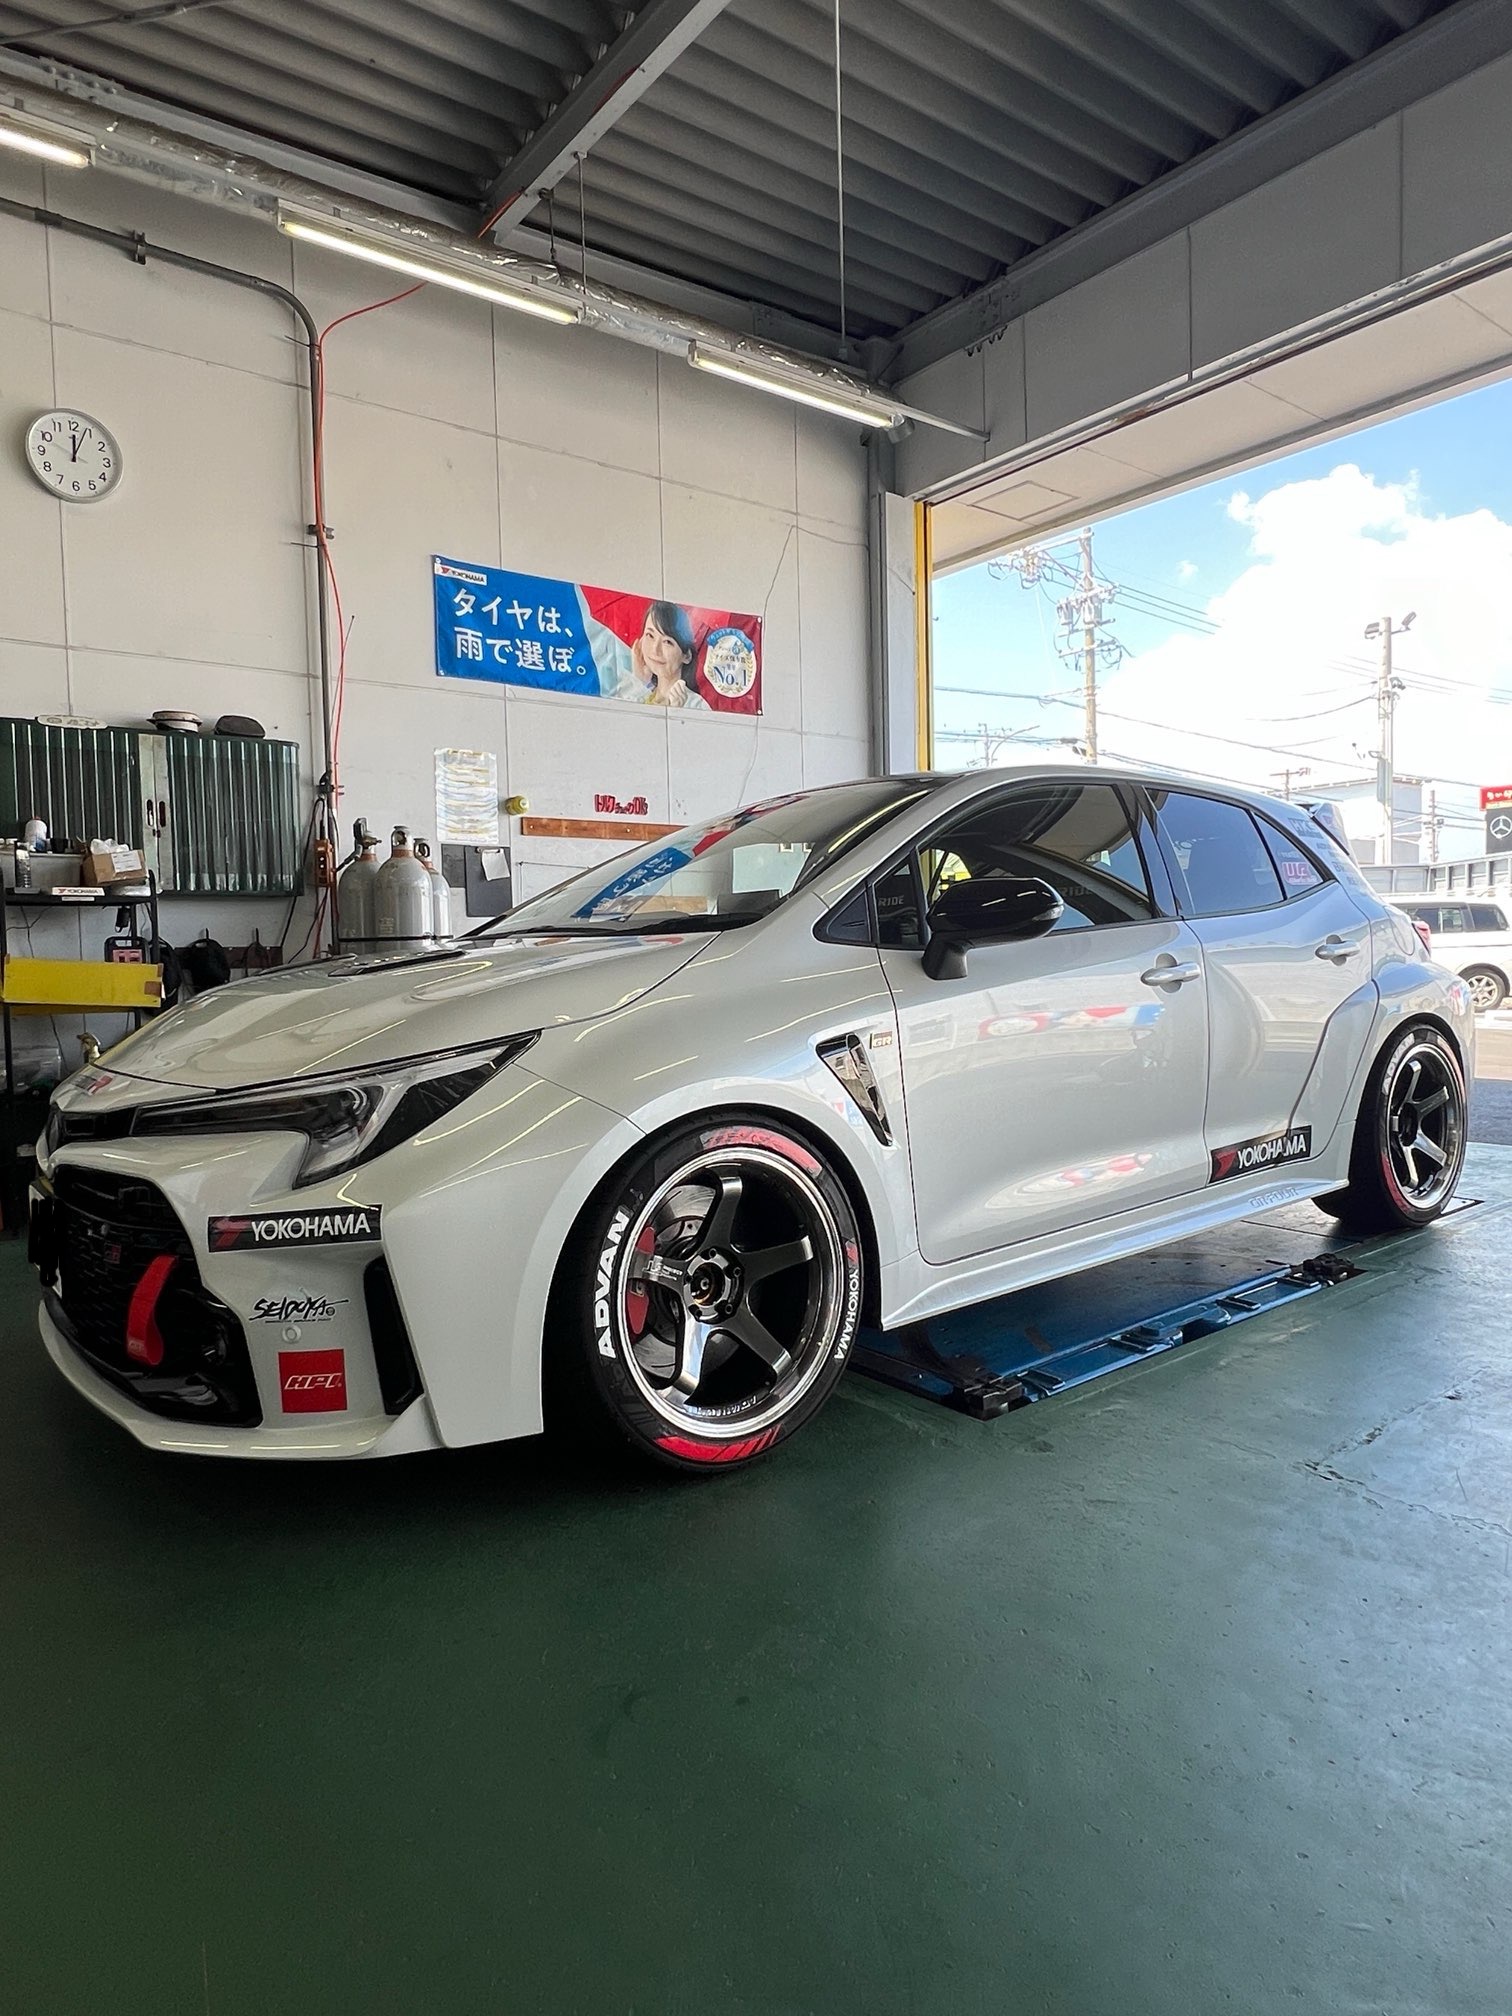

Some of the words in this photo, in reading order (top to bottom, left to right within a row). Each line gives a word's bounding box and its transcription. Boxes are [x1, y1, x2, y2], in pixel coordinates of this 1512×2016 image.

[52, 418, 61, 432] 11
[68, 420, 79, 432] 12
[41, 431, 53, 442] 10
[37, 445, 46, 456] 9
[98, 441, 106, 452] 2
[43, 461, 52, 472] 8
[103, 457, 111, 468] 3
[56, 474, 64, 485] 7
[99, 472, 107, 482] 4
[72, 481, 80, 491] 6
[88, 480, 97, 491] 5
[451, 570, 485, 583] YOKOHAMA
[453, 588, 573, 638] タイヤは、
[454, 626, 587, 676] 雨で選ぼ。
[713, 666, 747, 687] No.1
[878, 894, 905, 907] RIDE
[1238, 1134, 1307, 1169] YOKOHAMA
[251, 1213, 371, 1241] YOKOHAMA
[594, 1209, 630, 1359] ADVAN
[834, 1268, 860, 1360] YOKOHAMA
